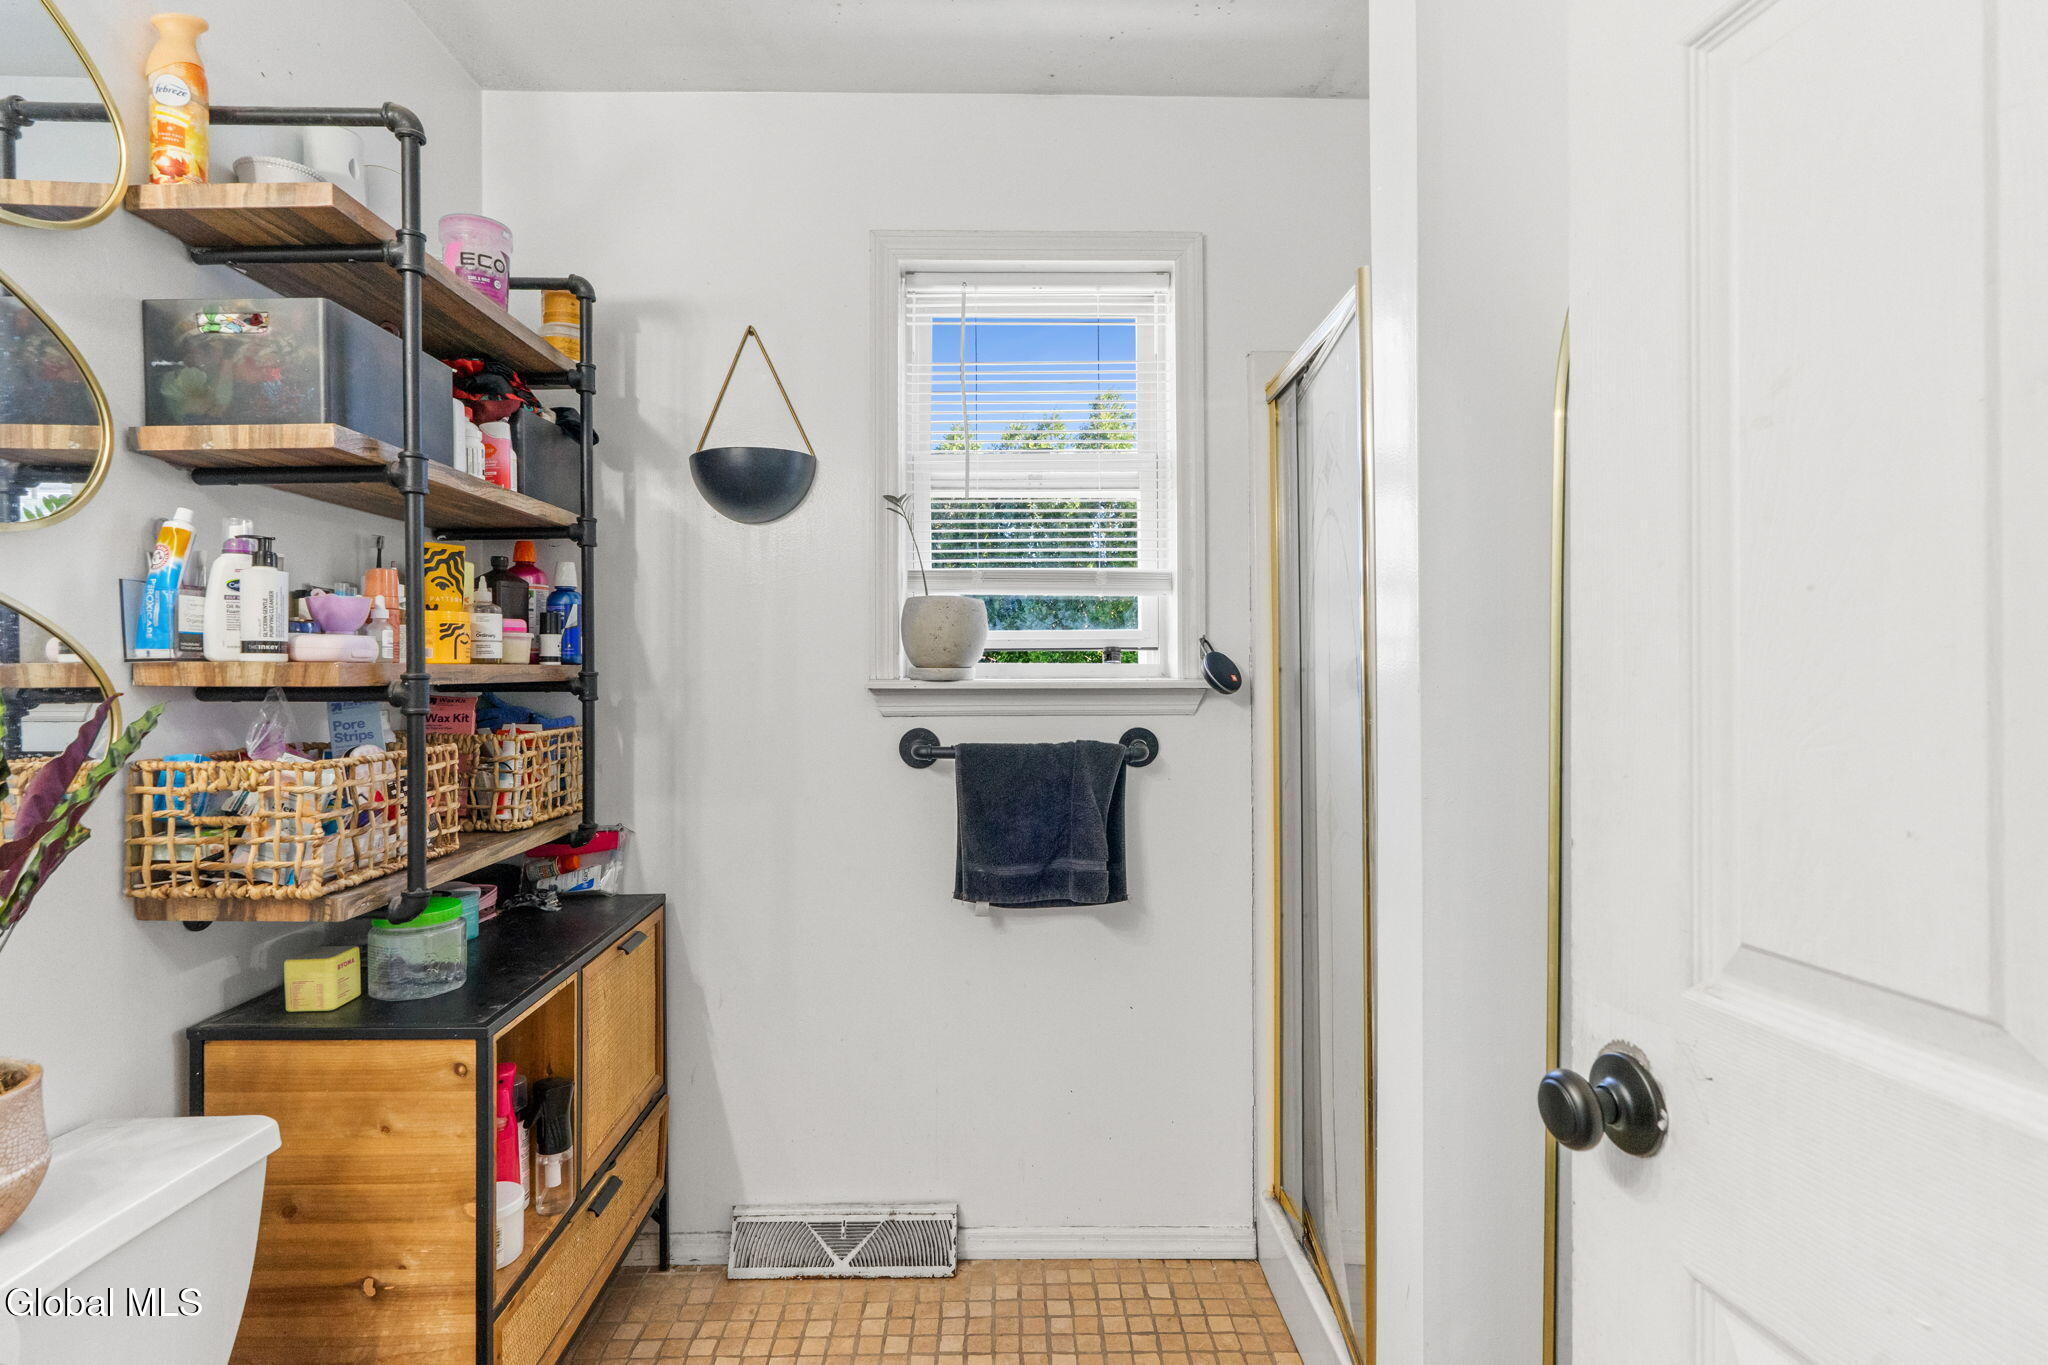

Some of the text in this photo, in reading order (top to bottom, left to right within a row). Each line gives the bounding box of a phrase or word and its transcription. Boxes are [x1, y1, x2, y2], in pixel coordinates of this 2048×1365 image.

[460, 252, 506, 274] ECO
[425, 713, 470, 723] Wax Kit
[332, 720, 366, 732] Pore
[334, 730, 375, 743] Strips
